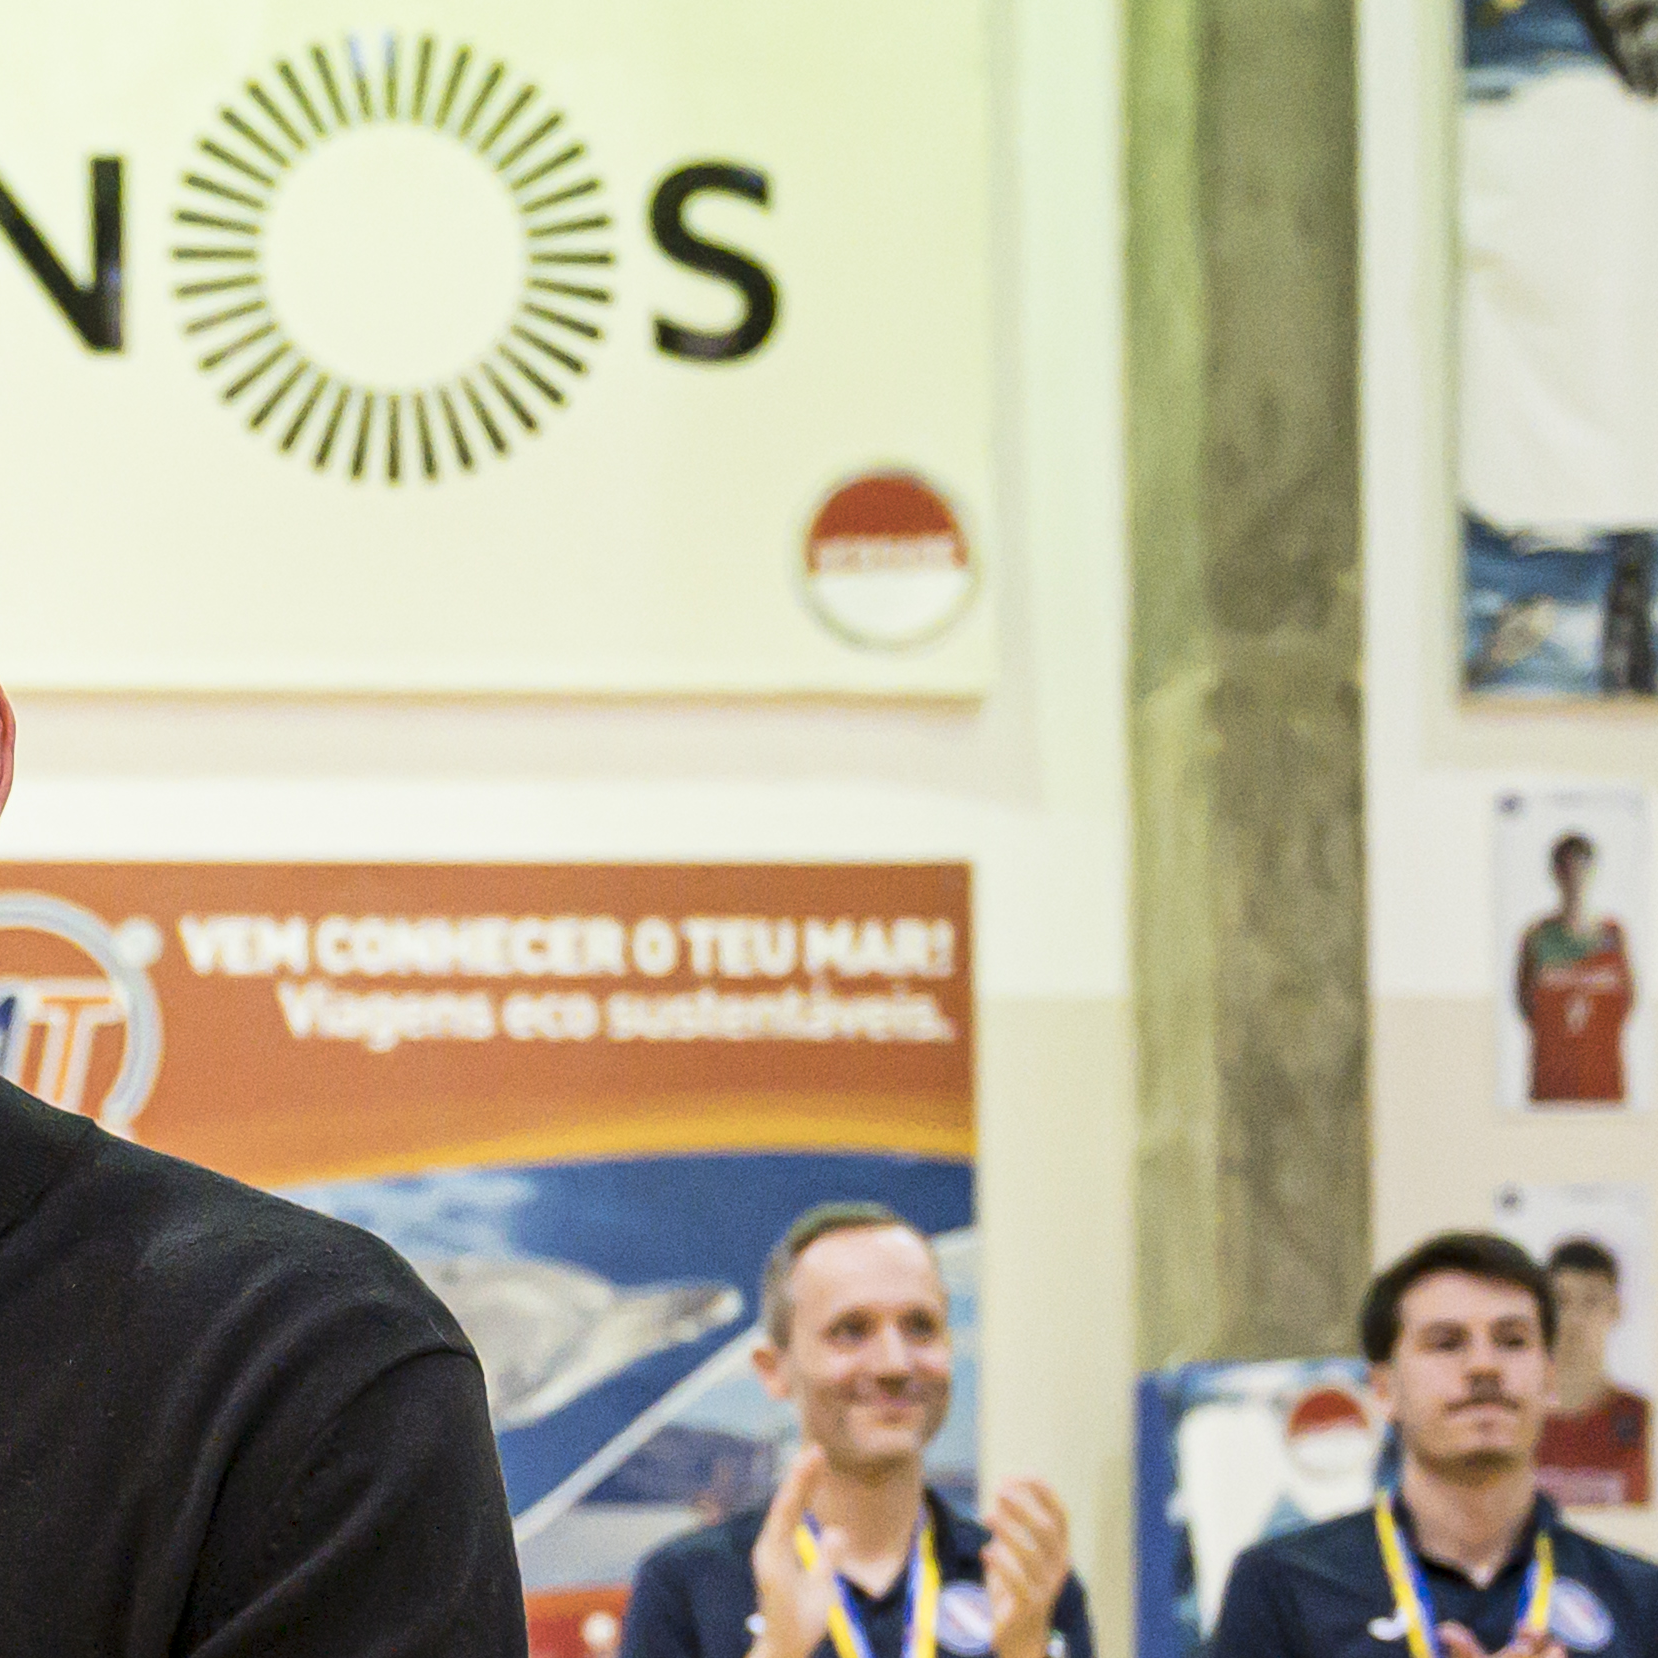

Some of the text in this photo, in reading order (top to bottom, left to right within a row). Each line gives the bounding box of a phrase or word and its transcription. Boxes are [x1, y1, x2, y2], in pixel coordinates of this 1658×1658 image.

[178, 913, 953, 977] VEM CONHECER O TEU MAR!
[277, 981, 496, 1053] Viagens
[501, 993, 600, 1043] eco
